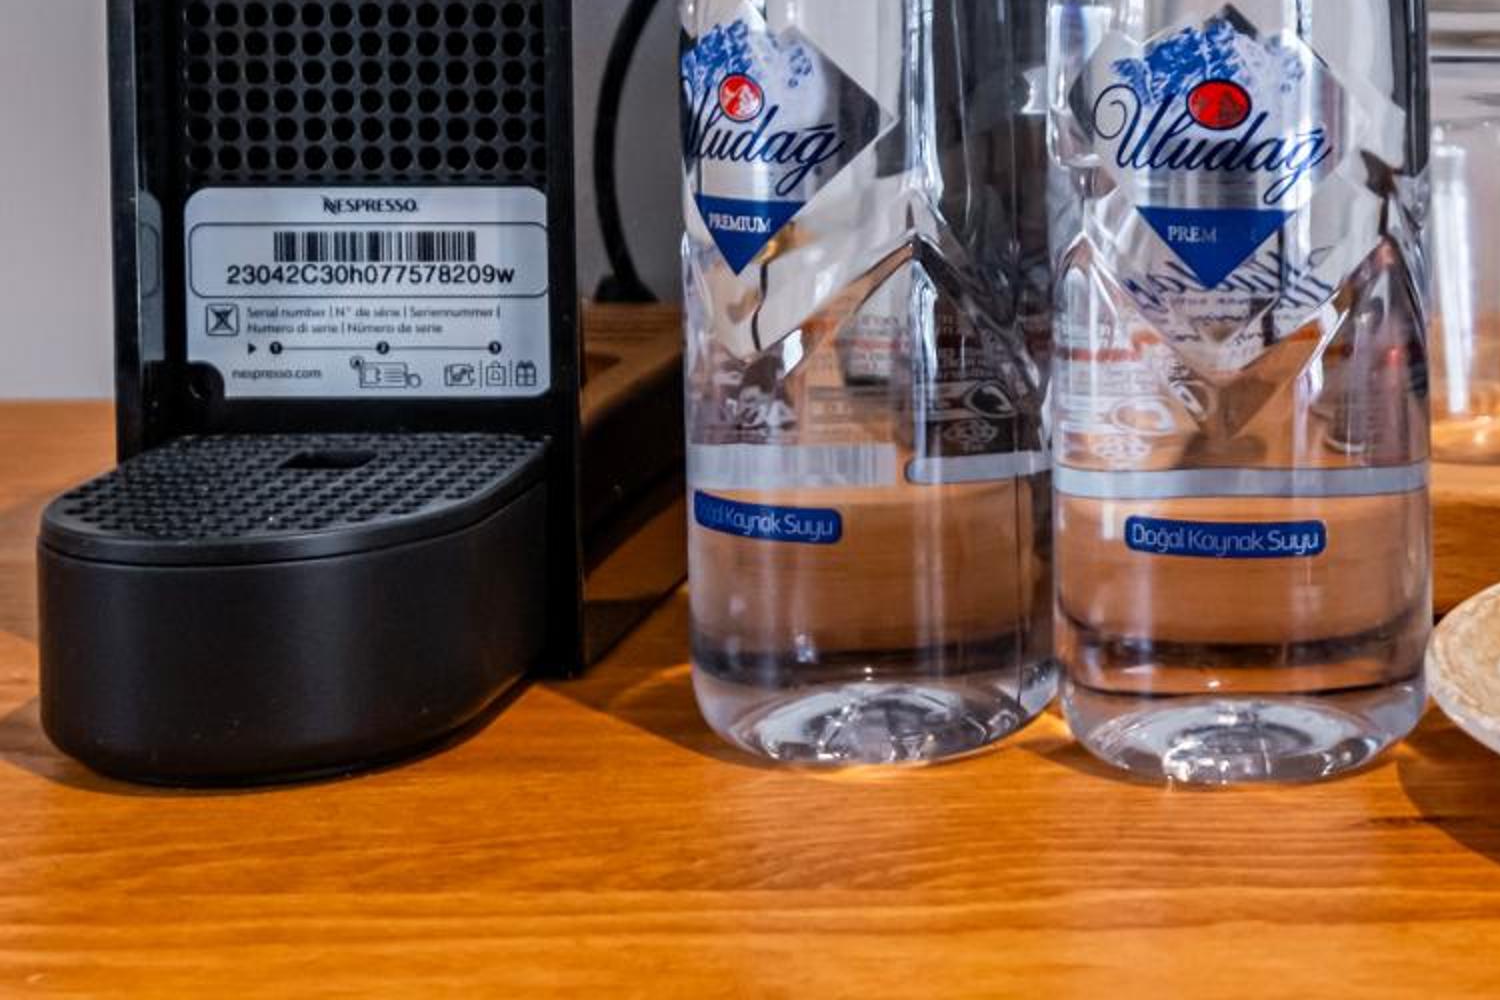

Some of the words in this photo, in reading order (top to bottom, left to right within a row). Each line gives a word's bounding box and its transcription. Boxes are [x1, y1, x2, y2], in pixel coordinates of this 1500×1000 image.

[1094, 84, 1333, 204] Uludağ
[321, 195, 417, 215] NESPRESSO
[708, 212, 771, 233] PREMIUM
[226, 264, 514, 286] 23042C30h077578209w
[281, 306, 325, 318] number
[231, 369, 322, 381] nespresso.com
[725, 506, 781, 535] Kaynak
[784, 513, 833, 541] Suyu
[1132, 523, 1185, 553] Doğal
[1187, 528, 1264, 557] Kaynak
[1267, 529, 1319, 555] Suyu
